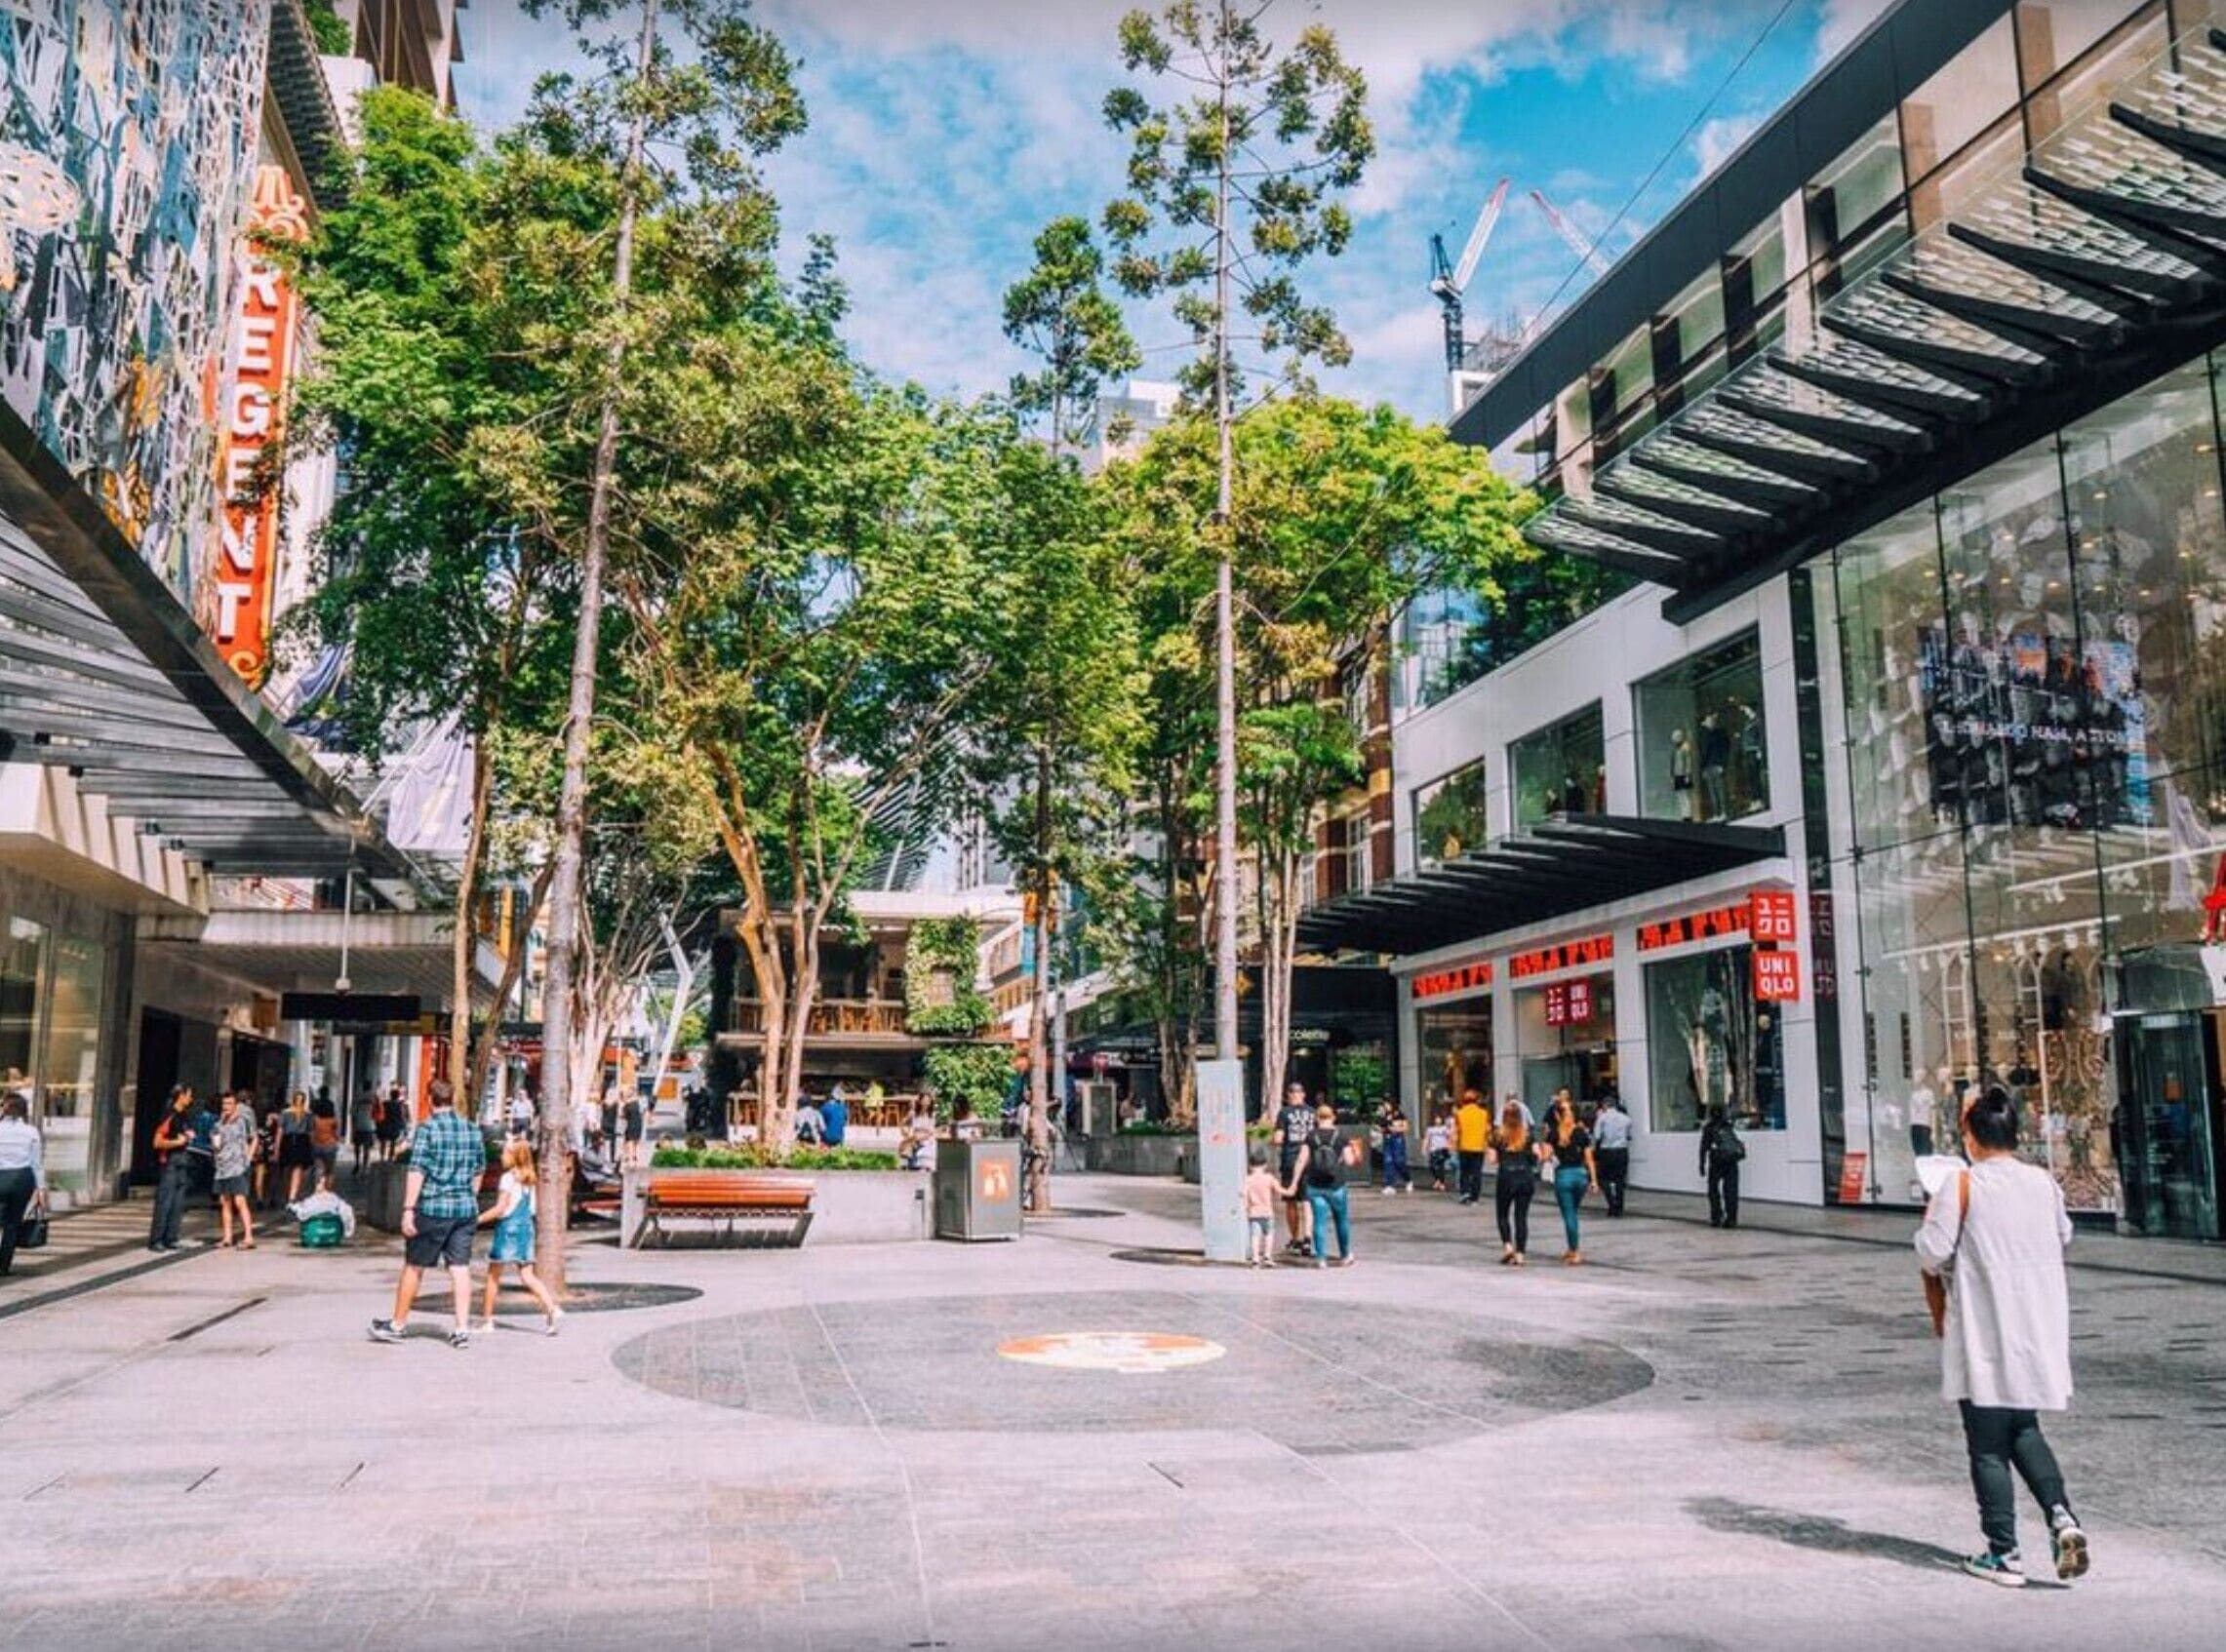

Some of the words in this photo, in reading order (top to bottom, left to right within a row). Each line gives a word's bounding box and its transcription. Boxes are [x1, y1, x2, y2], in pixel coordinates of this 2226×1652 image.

[219, 260, 281, 637] REGENT
[1759, 957, 1791, 973] UNI
[1761, 976, 1795, 995] QLO
